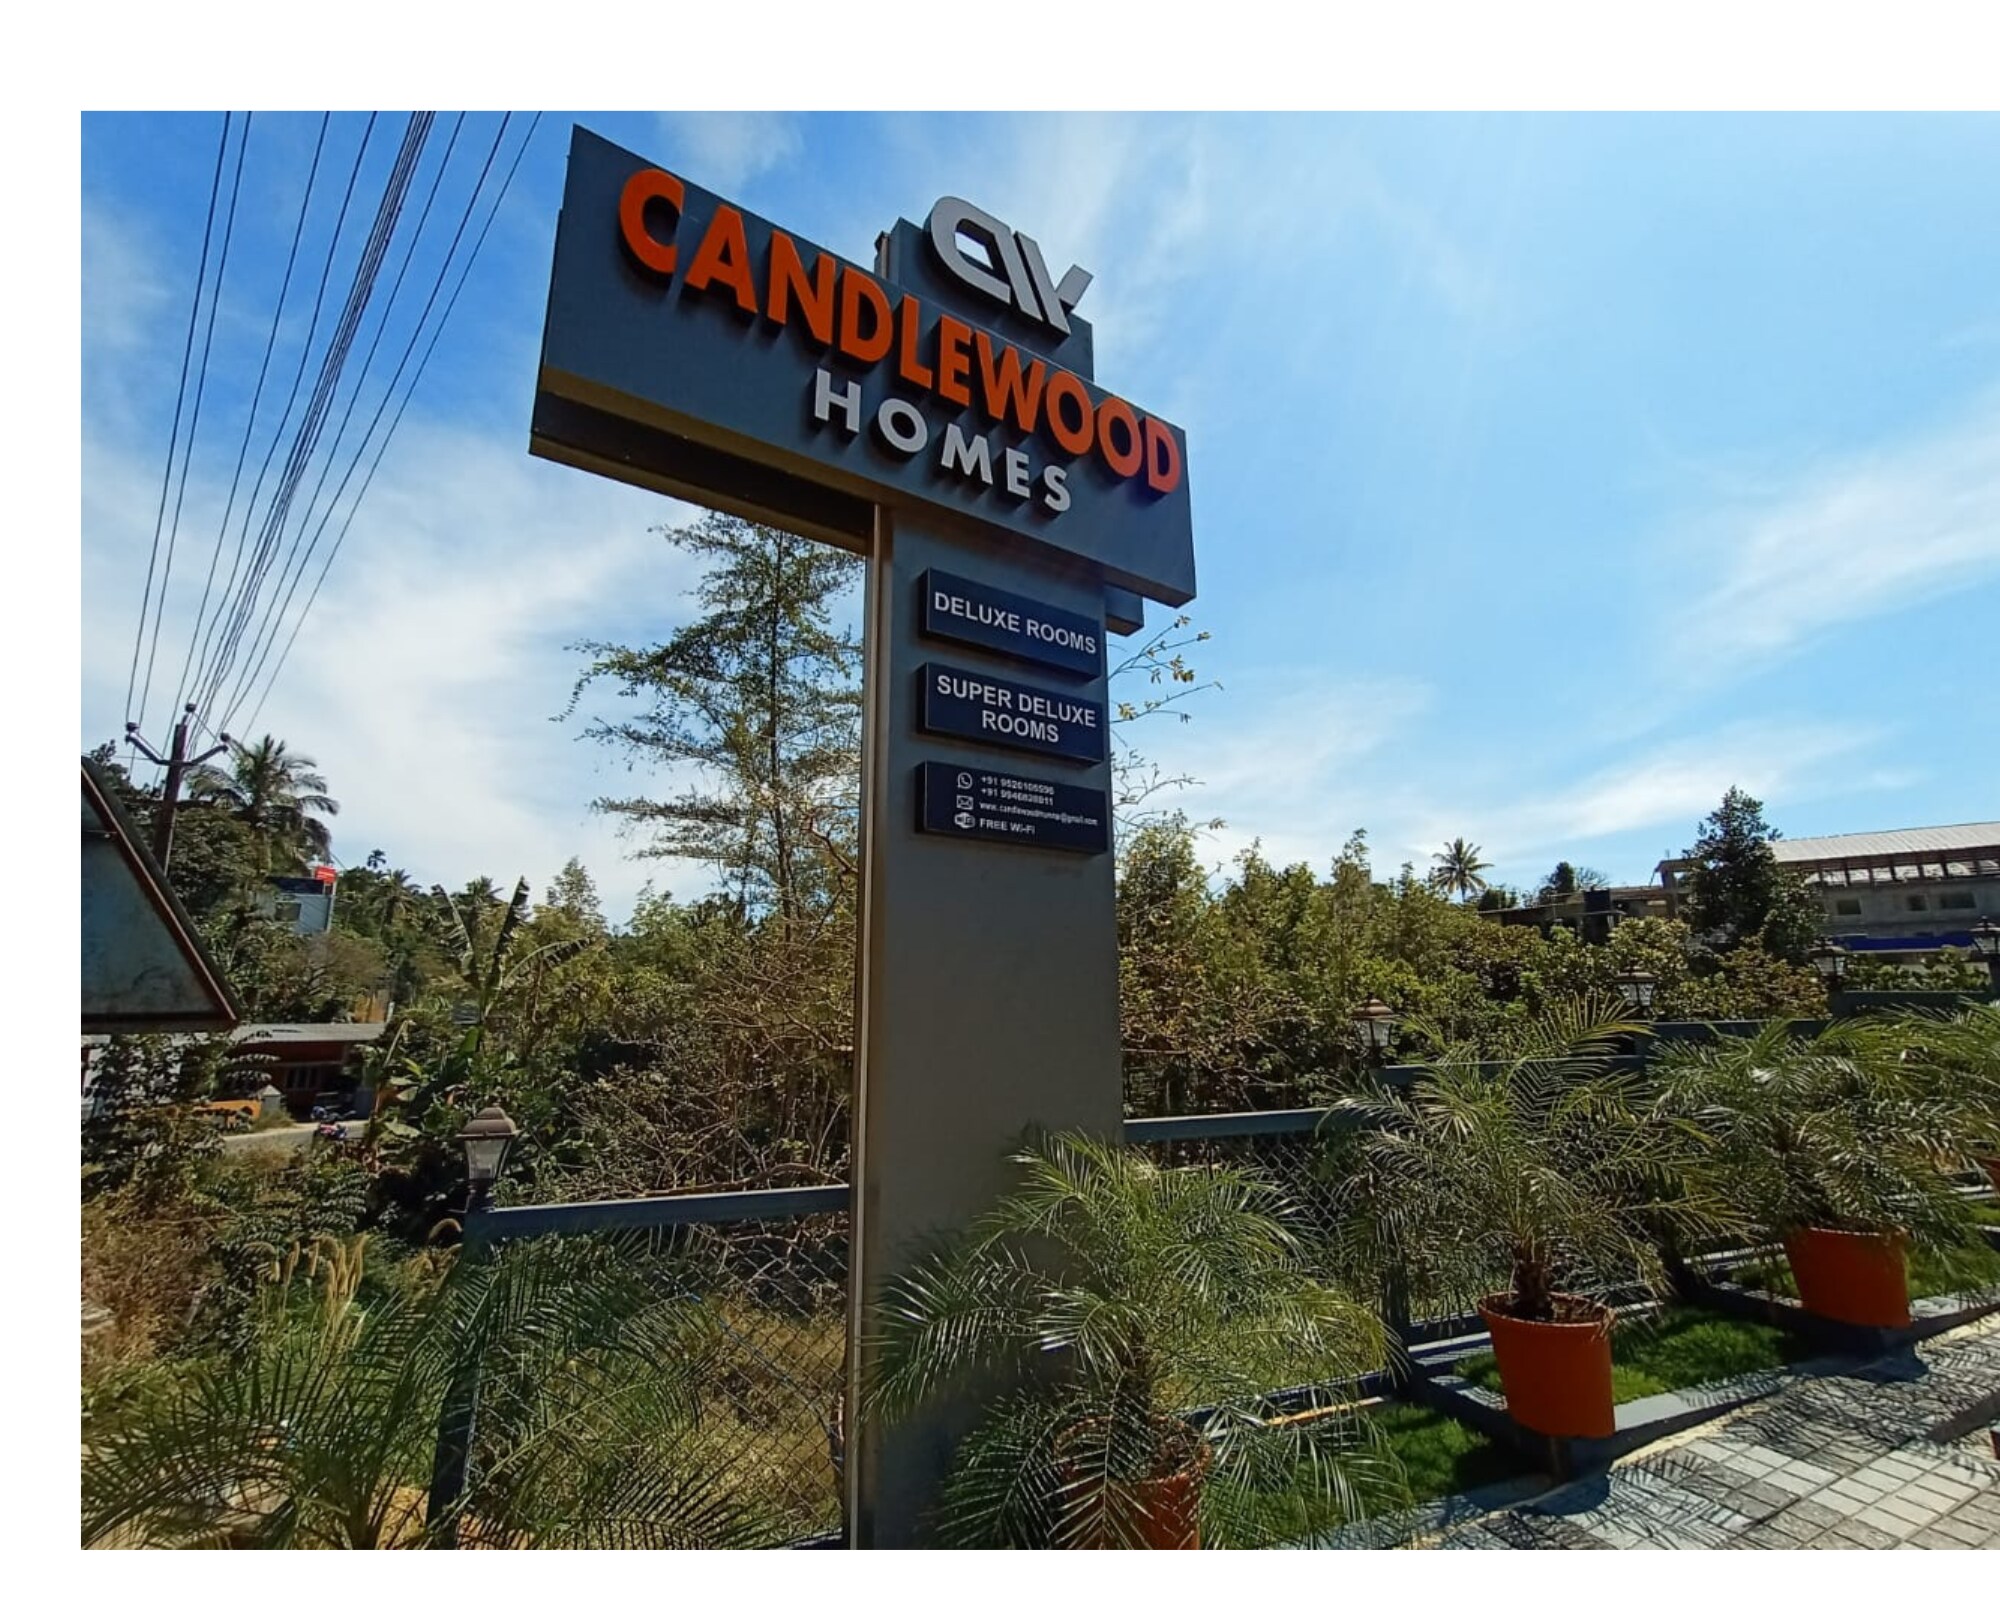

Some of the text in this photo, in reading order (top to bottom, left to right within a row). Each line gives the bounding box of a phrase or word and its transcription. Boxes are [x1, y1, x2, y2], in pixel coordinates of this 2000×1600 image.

[619, 168, 1180, 494] CANDLEWOOD
[813, 369, 1072, 514] HOMES
[934, 591, 1096, 653] DELUXE ROOMS
[936, 675, 1096, 727] SUPER DELUXE
[981, 709, 1059, 742] ROOMS
[981, 776, 998, 786] +91
[980, 817, 1008, 831] FREE
